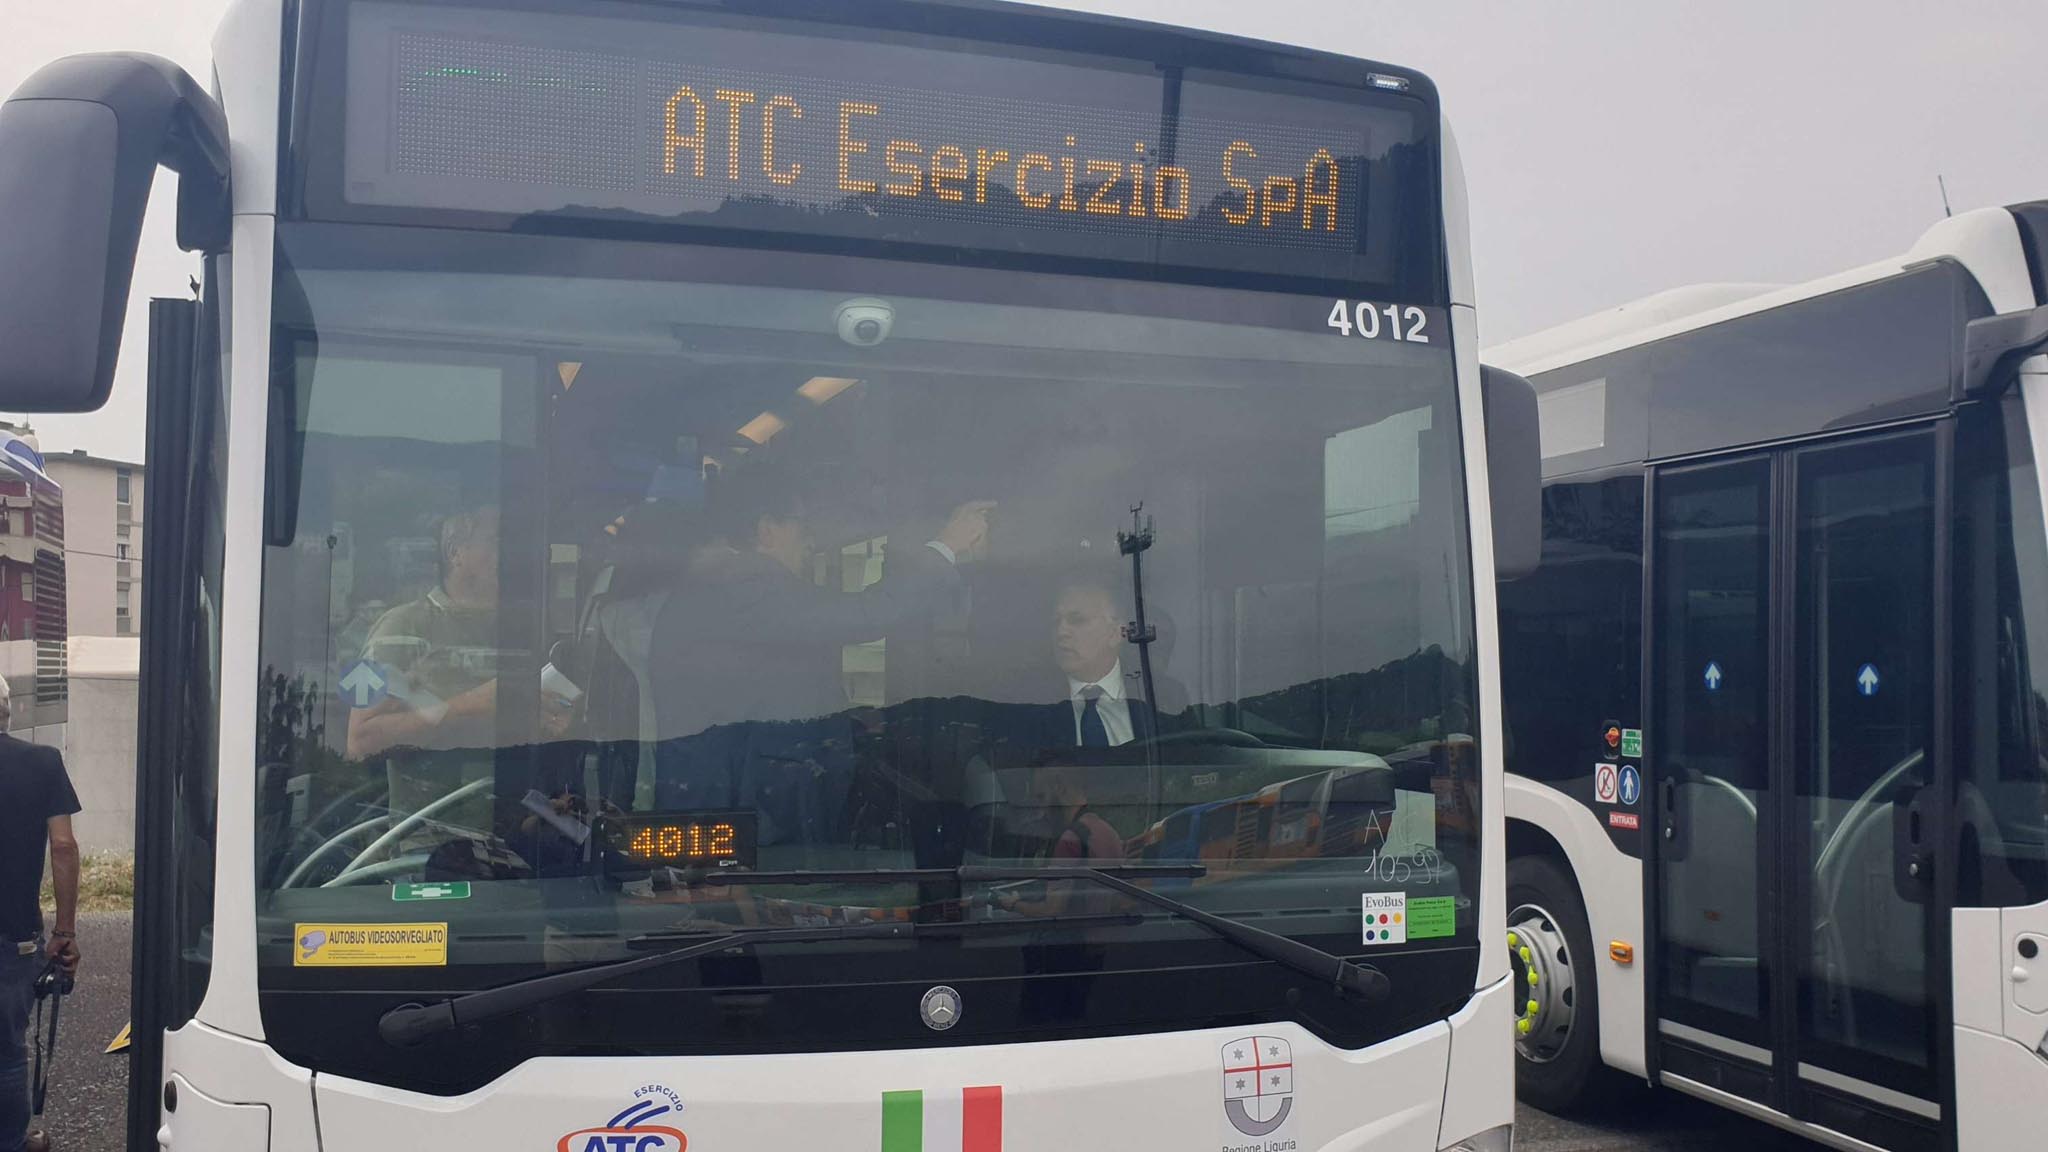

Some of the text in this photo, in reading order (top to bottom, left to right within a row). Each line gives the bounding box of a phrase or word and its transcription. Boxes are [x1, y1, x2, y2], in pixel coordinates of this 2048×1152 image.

[664, 86, 1339, 231] ATC Esercizio SpA
[1327, 299, 1429, 343] 4012
[1610, 814, 1638, 826] ENTRATA
[632, 823, 734, 857] 4012
[1365, 895, 1404, 908] EvoBus
[329, 930, 443, 944] AUTOBUS VIDEOSORVEGLIATO
[634, 1085, 684, 1112] ESERCIZIO
